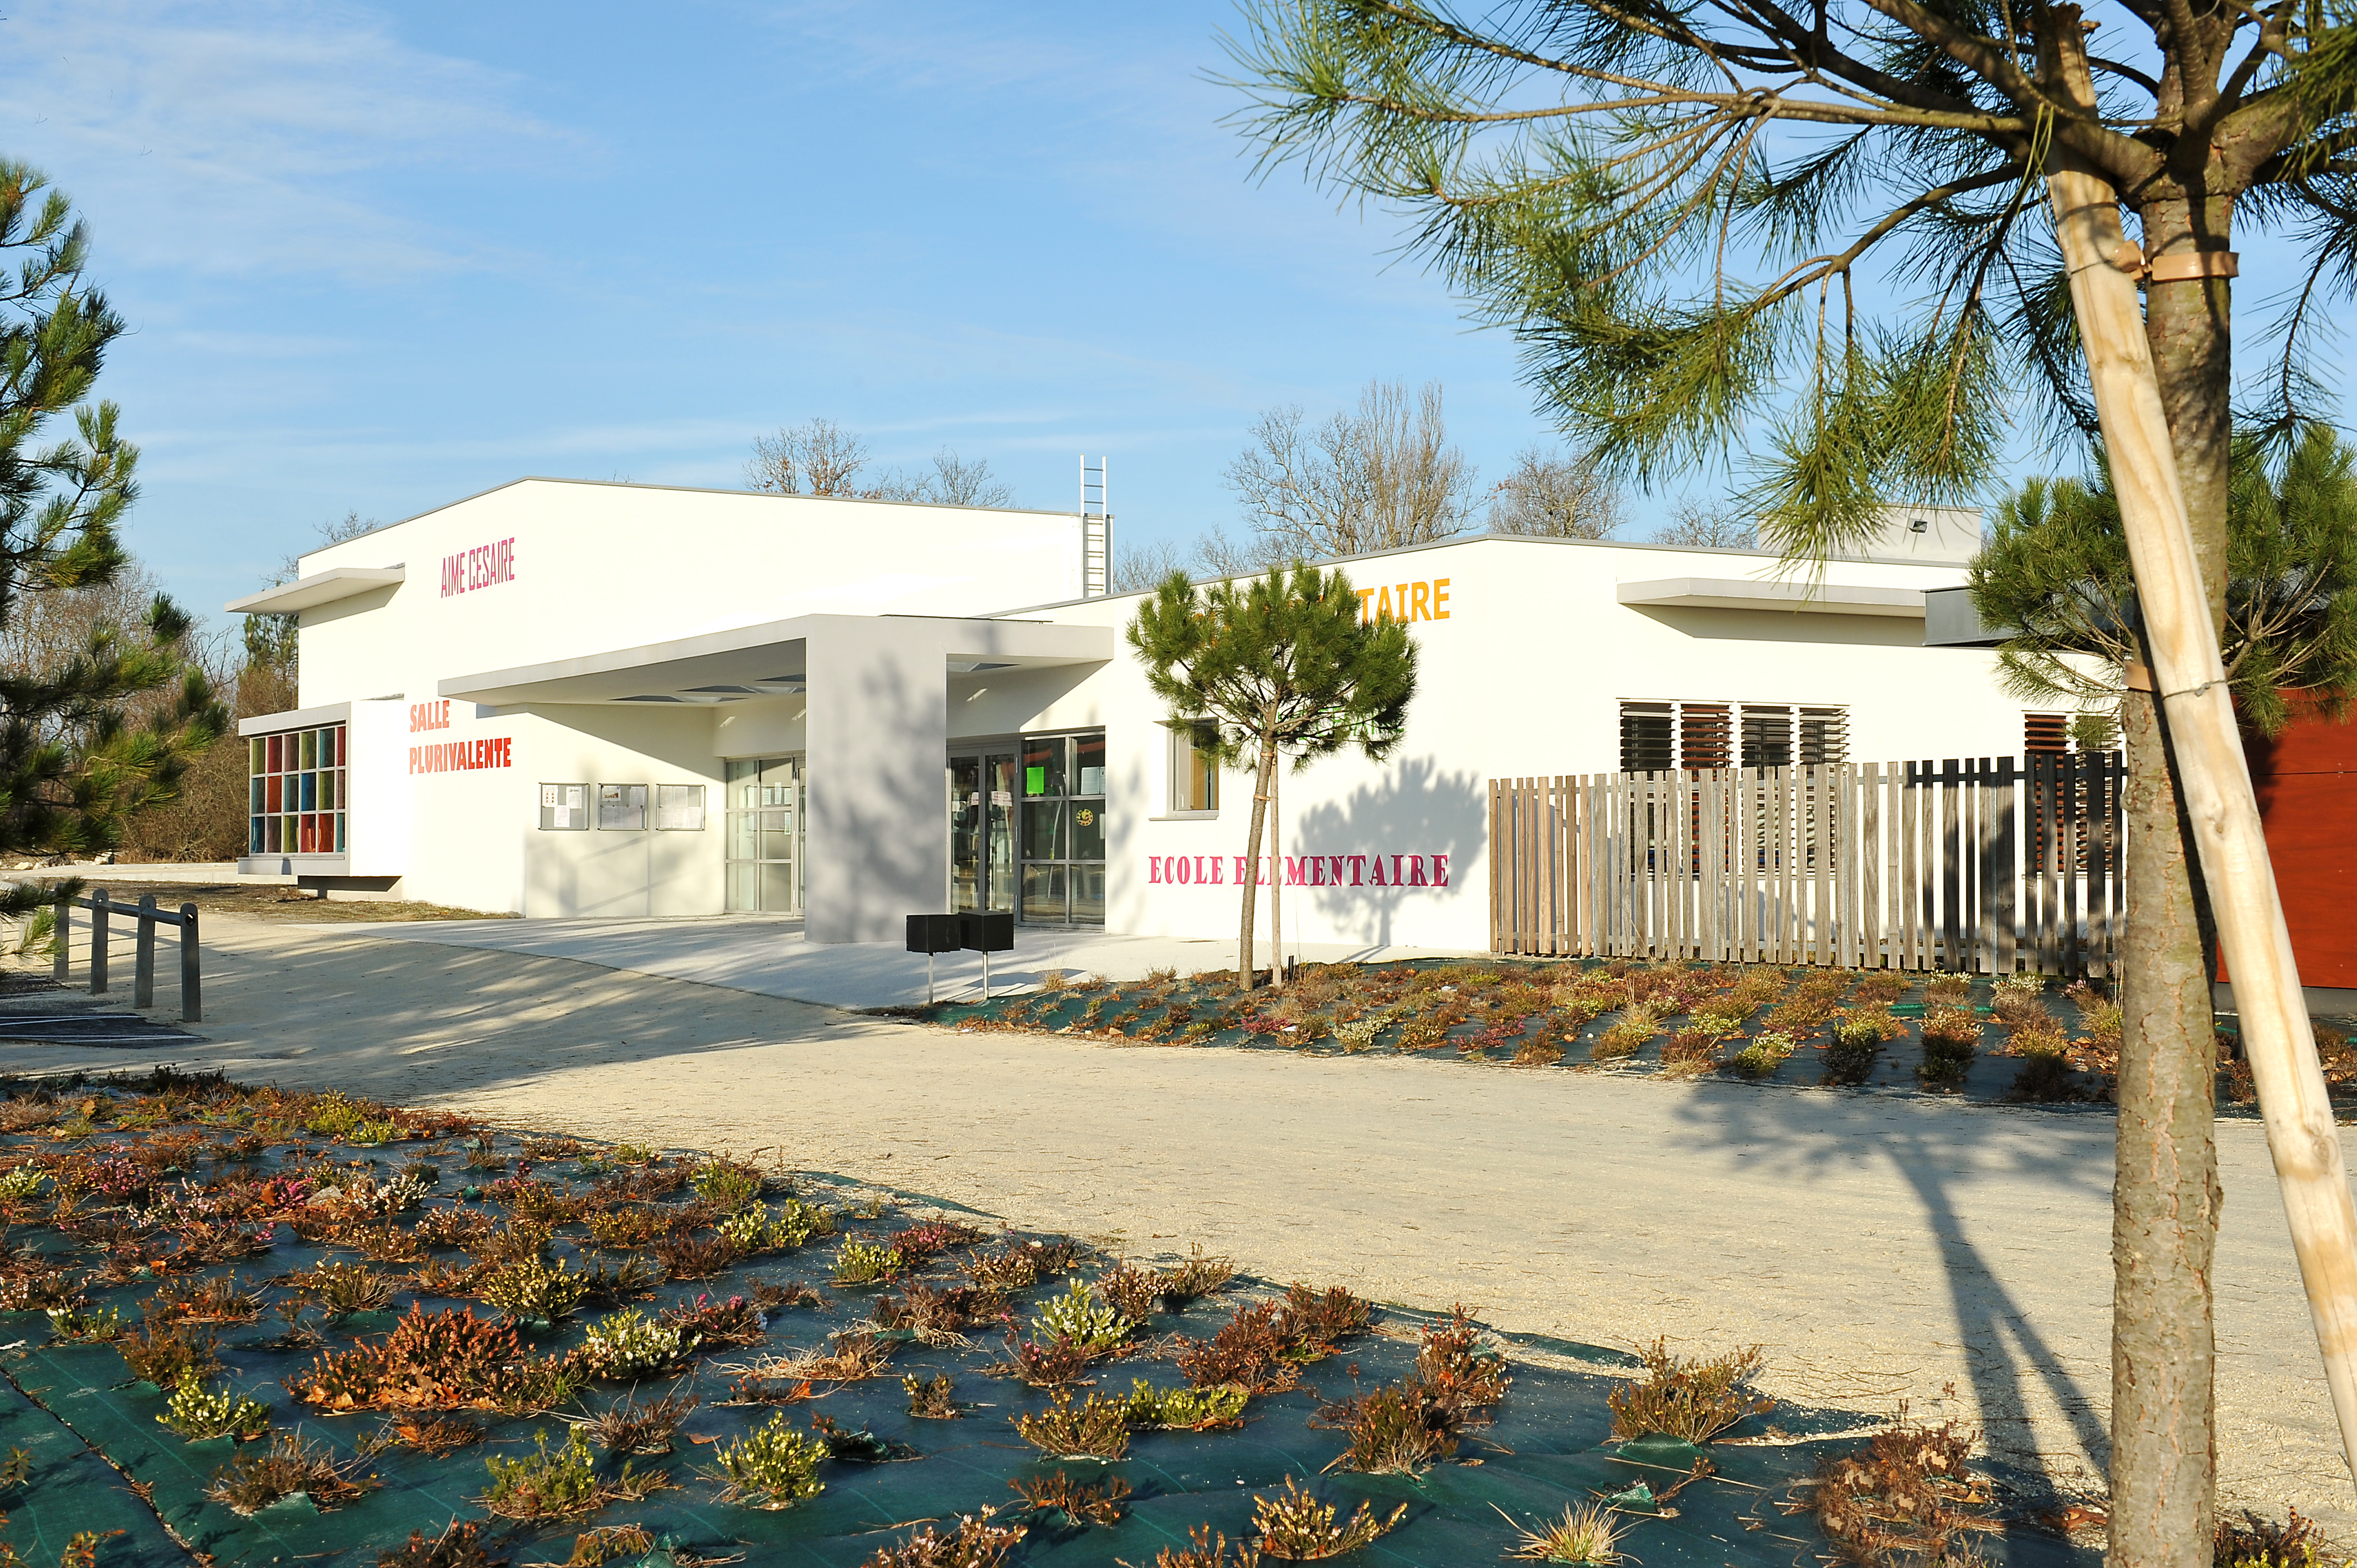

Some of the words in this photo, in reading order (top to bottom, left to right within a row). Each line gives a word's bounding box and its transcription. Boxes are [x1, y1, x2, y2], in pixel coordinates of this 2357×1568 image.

[441, 552, 466, 599] AIME
[469, 537, 515, 591] CESAIRE
[410, 700, 450, 733] SALLE
[409, 737, 511, 775] PLURIVALENTE
[1149, 856, 1223, 885] ECOLE
